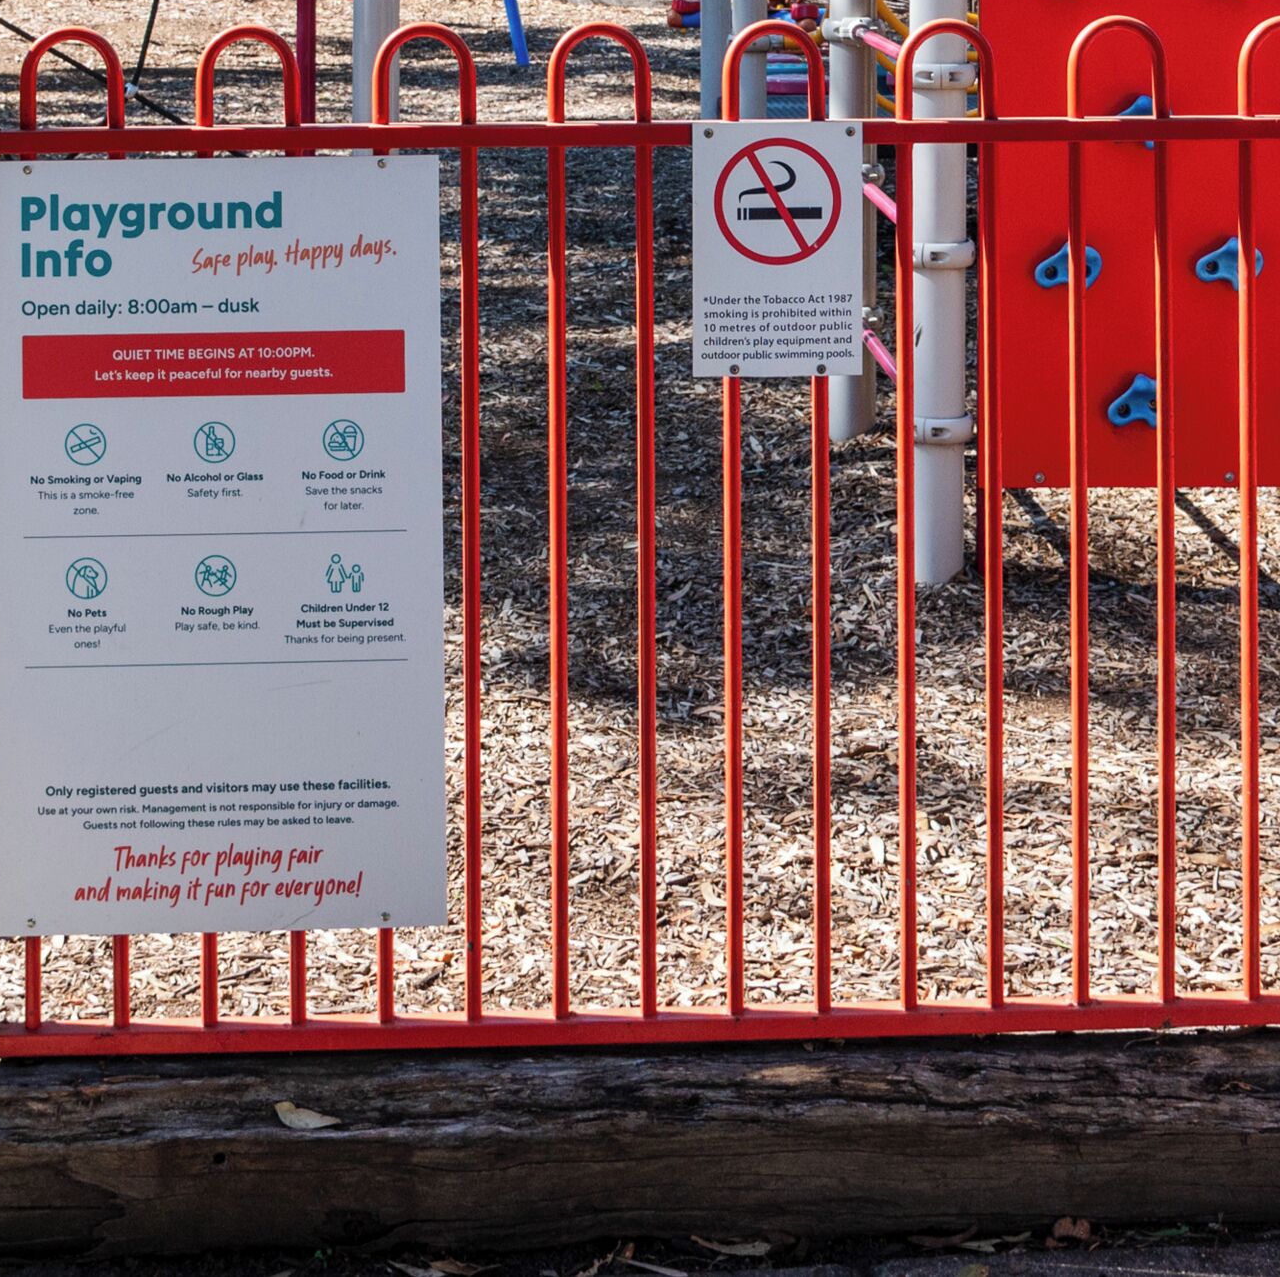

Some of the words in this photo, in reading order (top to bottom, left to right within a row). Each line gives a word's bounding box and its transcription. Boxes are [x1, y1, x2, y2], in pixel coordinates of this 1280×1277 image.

[20, 190, 282, 240] Playground
[21, 235, 112, 277] Info
[191, 247, 231, 275] Safe
[236, 244, 277, 276] play.
[284, 238, 343, 270] Happy
[349, 233, 396, 264] days.
[743, 295, 761, 304] the
[762, 294, 805, 304] Tobacco
[807, 294, 824, 303] Act
[828, 293, 852, 303] 1987
[21, 300, 70, 319] Open
[75, 299, 122, 318] daily:
[127, 298, 197, 314] 8:00am
[217, 297, 259, 313] dusk
[703, 309, 748, 320] smoking
[751, 309, 759, 318] is
[762, 307, 816, 320] prohibited
[819, 307, 851, 317] within
[704, 323, 716, 332] 10
[719, 324, 756, 332] metres
[759, 322, 770, 332] of
[772, 322, 816, 331] outdoor
[819, 321, 852, 332] public
[753, 336, 774, 348] play
[776, 336, 831, 347] equipment
[833, 334, 852, 344] and
[112, 348, 152, 360] QUIET
[154, 348, 184, 359] TIME
[188, 347, 235, 359] BEGINS
[238, 347, 255, 358] AT
[257, 346, 315, 358] 10:00PM.
[700, 350, 740, 359] outdoor
[742, 349, 772, 361] public
[774, 349, 824, 360] swimming
[826, 348, 854, 359] pools.
[124, 369, 154, 382] keep
[157, 368, 166, 379] it
[169, 367, 221, 382] peaceful
[224, 367, 242, 378] for
[245, 367, 287, 380] nearby
[289, 367, 333, 380] guests.
[30, 475, 45, 484] No
[47, 474, 91, 486] Smoking
[106, 473, 142, 485] Vaping
[166, 473, 181, 482] No
[183, 472, 221, 482] Alcohol
[236, 471, 263, 481] Glass
[301, 471, 316, 480] No
[318, 470, 344, 479] Food
[359, 469, 385, 479] Drink
[37, 490, 57, 500] This
[78, 489, 134, 499] smoke-free
[187, 488, 219, 499] Safety
[221, 487, 243, 497] first.
[305, 485, 328, 495] Save
[331, 486, 347, 495] the
[349, 485, 382, 495] snacks
[73, 507, 99, 515] zone.
[323, 501, 337, 510] for
[340, 501, 364, 510] later.
[67, 608, 82, 617] No
[84, 608, 107, 617] Pets
[181, 606, 196, 615] No
[198, 606, 230, 617] Rough
[232, 605, 254, 616] Play
[300, 603, 343, 613] Children
[345, 603, 376, 612] Under
[378, 602, 389, 611] 12
[48, 624, 72, 633] Even
[74, 624, 91, 633] the
[93, 623, 126, 634] playful
[174, 621, 195, 633] Play
[197, 621, 220, 631] safe,
[222, 621, 235, 630] be
[237, 620, 260, 629] kind.
[296, 619, 321, 628] Must
[323, 619, 336, 628] be
[338, 617, 394, 629] Supervised
[73, 639, 100, 648] ones!
[284, 634, 318, 644] Thanks
[320, 634, 335, 643] for
[337, 633, 364, 645] being
[366, 633, 406, 644] present.
[45, 785, 73, 799] Only
[76, 784, 136, 798] registered
[139, 784, 178, 797] guests
[181, 782, 202, 793] and
[205, 782, 248, 793] visitors
[251, 783, 276, 794] may
[279, 783, 299, 791] use
[302, 780, 335, 791] these
[337, 778, 390, 790] facilities.
[37, 806, 56, 815] Use
[58, 807, 68, 815] at
[71, 807, 93, 817] your
[119, 804, 142, 813] risk.
[142, 803, 206, 815] Management
[209, 802, 217, 812] is
[219, 803, 236, 811] not
[238, 801, 295, 812] responsible
[297, 800, 312, 809] for
[314, 799, 342, 811] injury
[357, 799, 399, 809] damage.
[82, 820, 118, 830] Guests
[120, 820, 136, 828] not
[139, 819, 185, 830] following
[187, 818, 215, 827] these
[217, 817, 241, 827] rules
[243, 818, 265, 828] may
[266, 817, 279, 826] be
[281, 816, 310, 825] asked
[312, 816, 323, 824] to
[325, 815, 354, 824] leave.
[113, 844, 176, 871] Thanks
[180, 849, 210, 874] for
[214, 843, 282, 876] playing
[286, 845, 323, 872] fair
[74, 877, 111, 902] and
[116, 877, 181, 907] making
[186, 877, 202, 900] it
[204, 874, 235, 906] fun
[239, 873, 270, 905] for
[274, 870, 363, 906] everyone!
